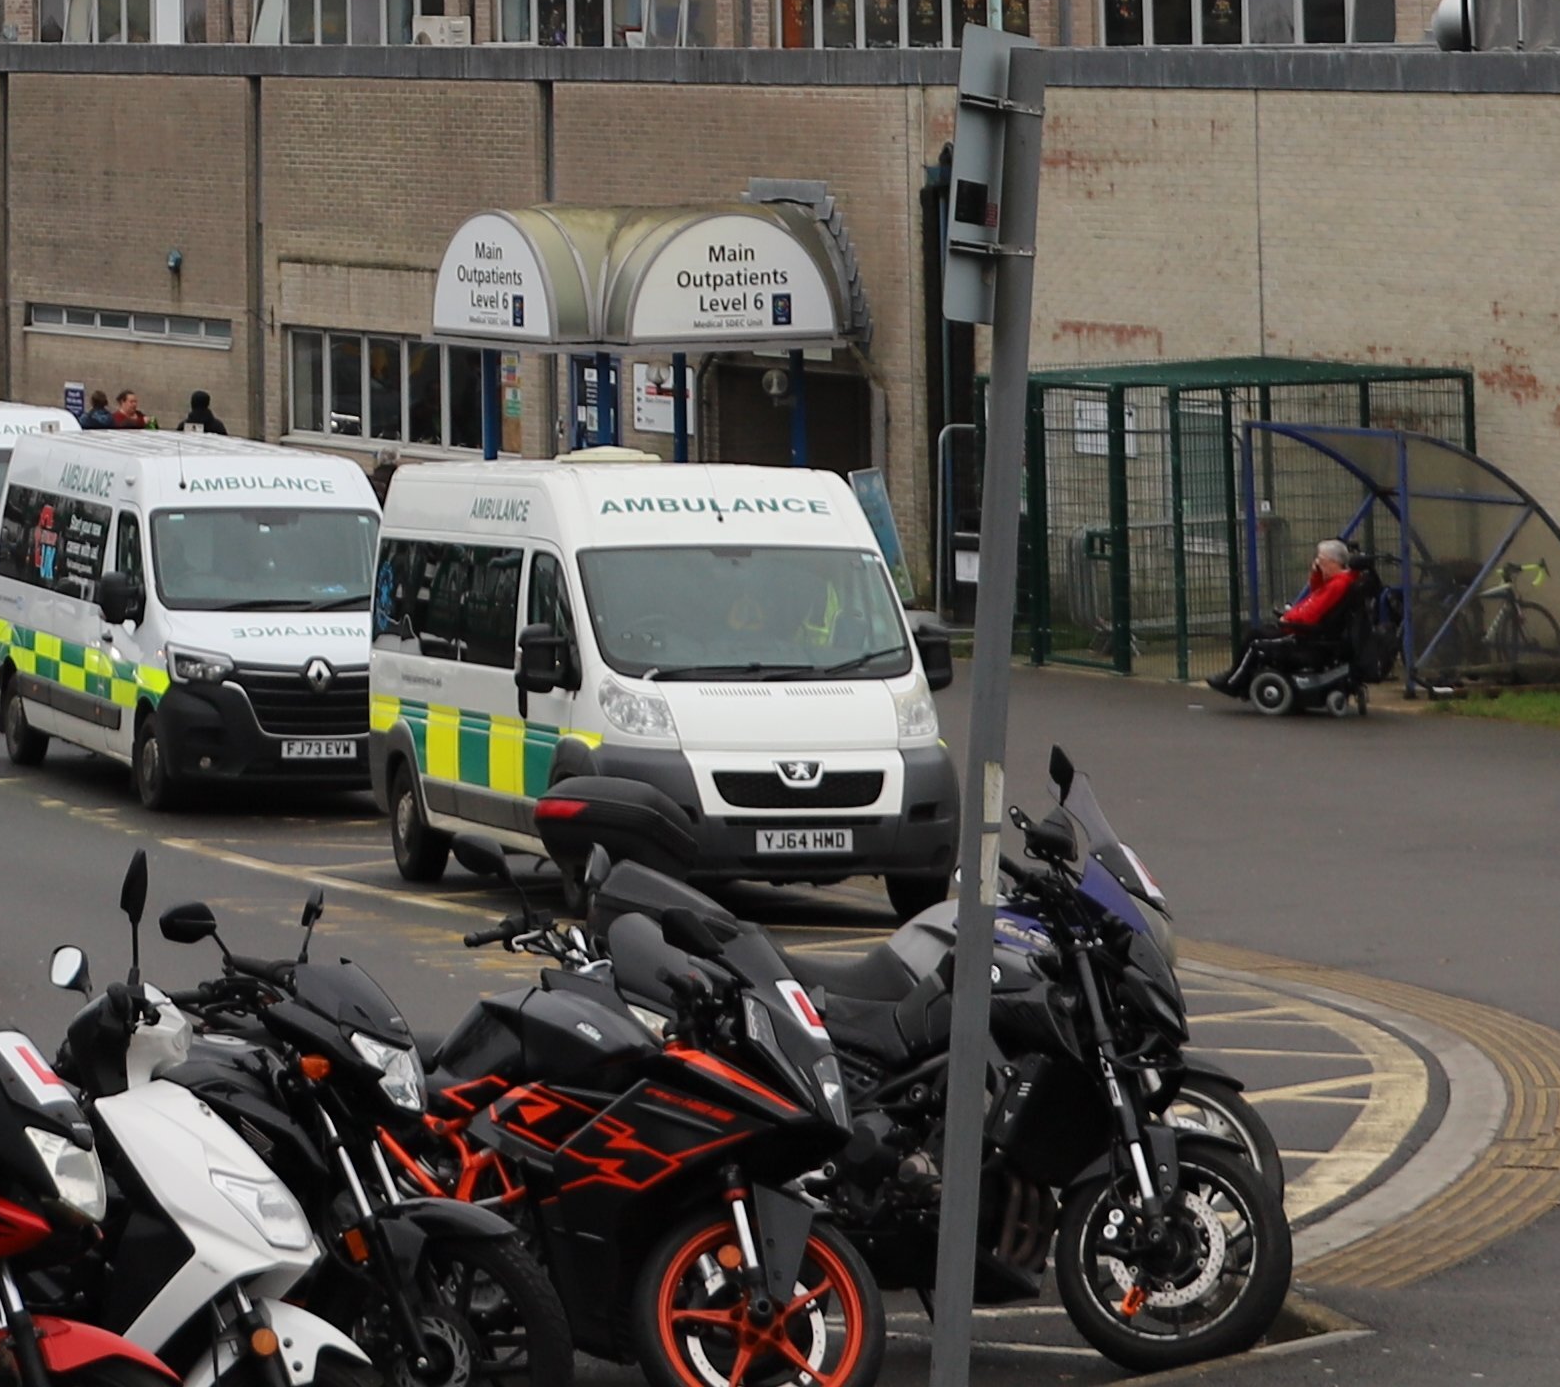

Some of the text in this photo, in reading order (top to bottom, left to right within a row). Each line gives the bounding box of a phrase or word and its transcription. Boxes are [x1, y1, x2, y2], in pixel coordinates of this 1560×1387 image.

[475, 241, 503, 260] Main
[708, 243, 755, 263] Main
[457, 264, 523, 288] Outpatients
[677, 268, 788, 291] Outpatients
[470, 289, 509, 310] Level 6
[699, 292, 764, 312] Level 6
[693, 318, 723, 328] Medical
[747, 318, 763, 326] Unit
[58, 462, 114, 498] AMBULANCE
[189, 476, 336, 494] AMBULANCE
[470, 497, 530, 523] AMBULANCE
[599, 496, 832, 517] AMBULANCE
[287, 741, 322, 755] FJ73
[764, 831, 845, 849] YJ64 HMD
